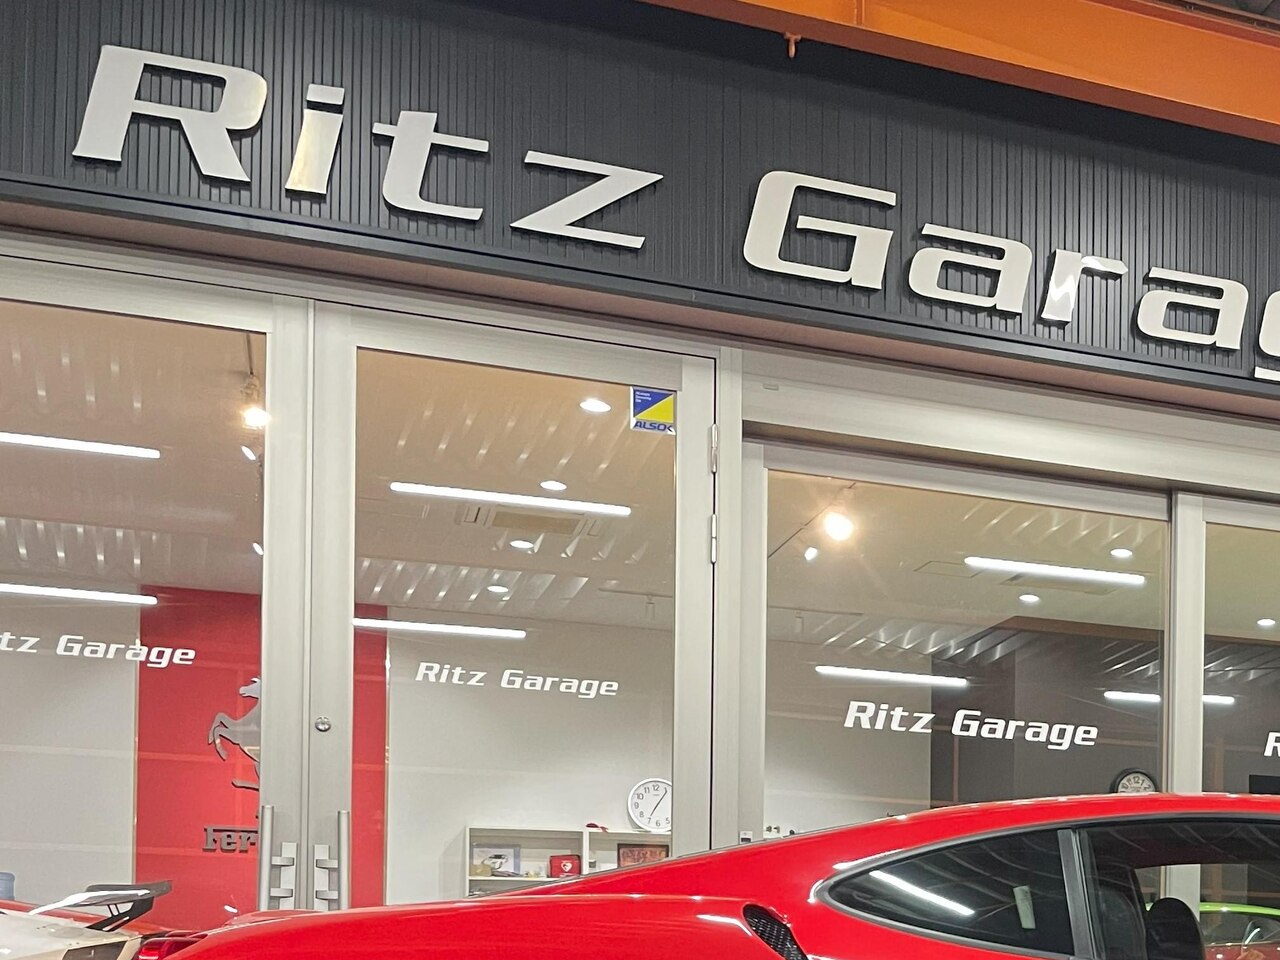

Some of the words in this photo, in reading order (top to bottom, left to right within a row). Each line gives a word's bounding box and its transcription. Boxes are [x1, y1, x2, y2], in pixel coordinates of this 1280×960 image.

[72, 45, 664, 249] Ritz
[0, 632, 40, 653] tz
[56, 634, 196, 668] Garage
[415, 662, 487, 686] Ritz
[500, 669, 619, 699] Garage
[843, 700, 935, 733] Ritz
[951, 709, 1098, 751] Garage
[644, 786, 650, 794] 11
